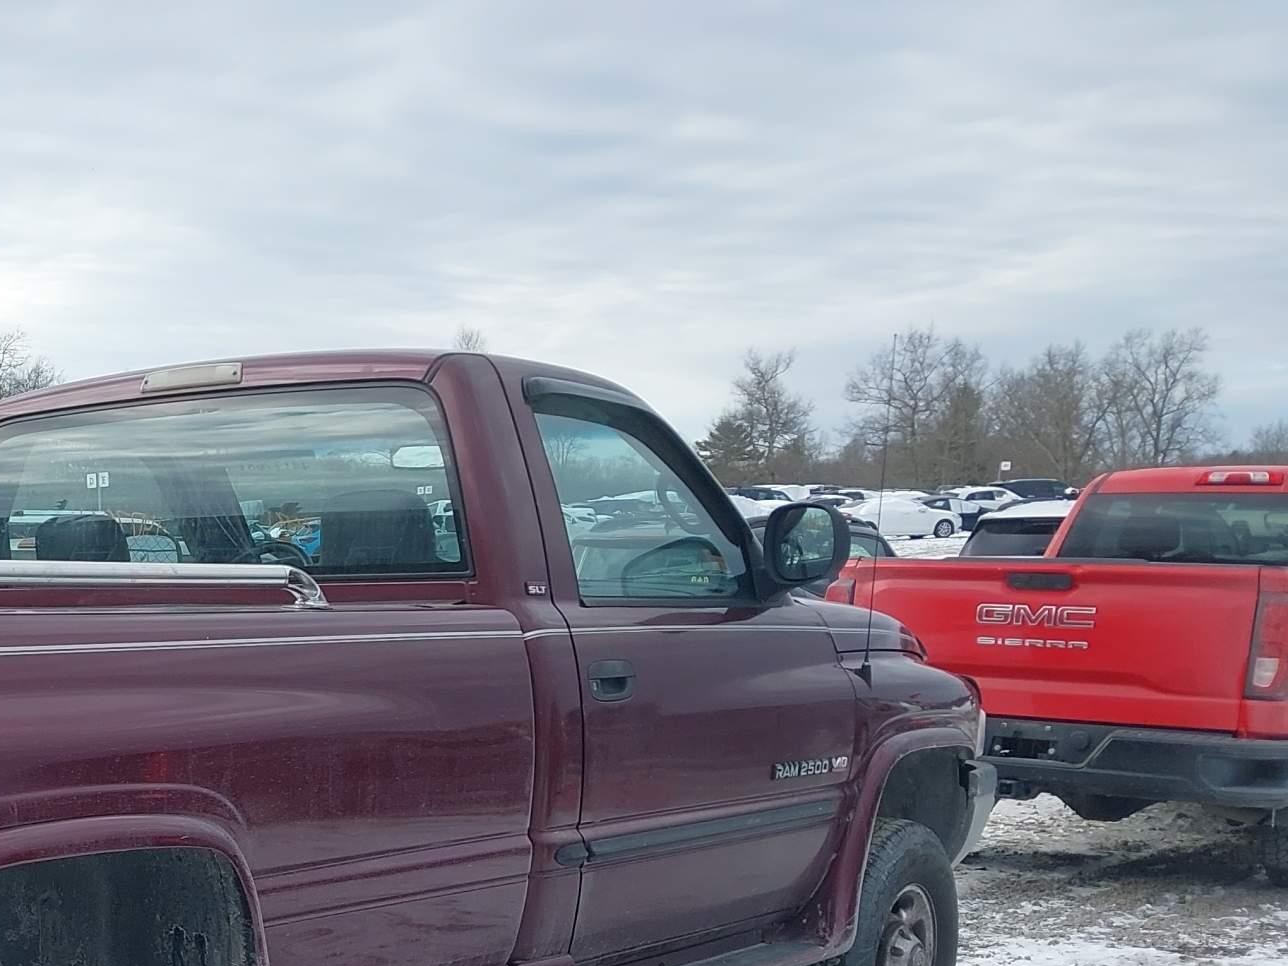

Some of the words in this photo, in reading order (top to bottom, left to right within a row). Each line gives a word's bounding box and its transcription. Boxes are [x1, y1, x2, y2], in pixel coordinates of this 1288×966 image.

[528, 585, 546, 594] SLT
[976, 603, 1096, 628] GMC
[976, 636, 1088, 649] SIERRA
[775, 762, 799, 779] RAM
[800, 759, 830, 776] 2500
